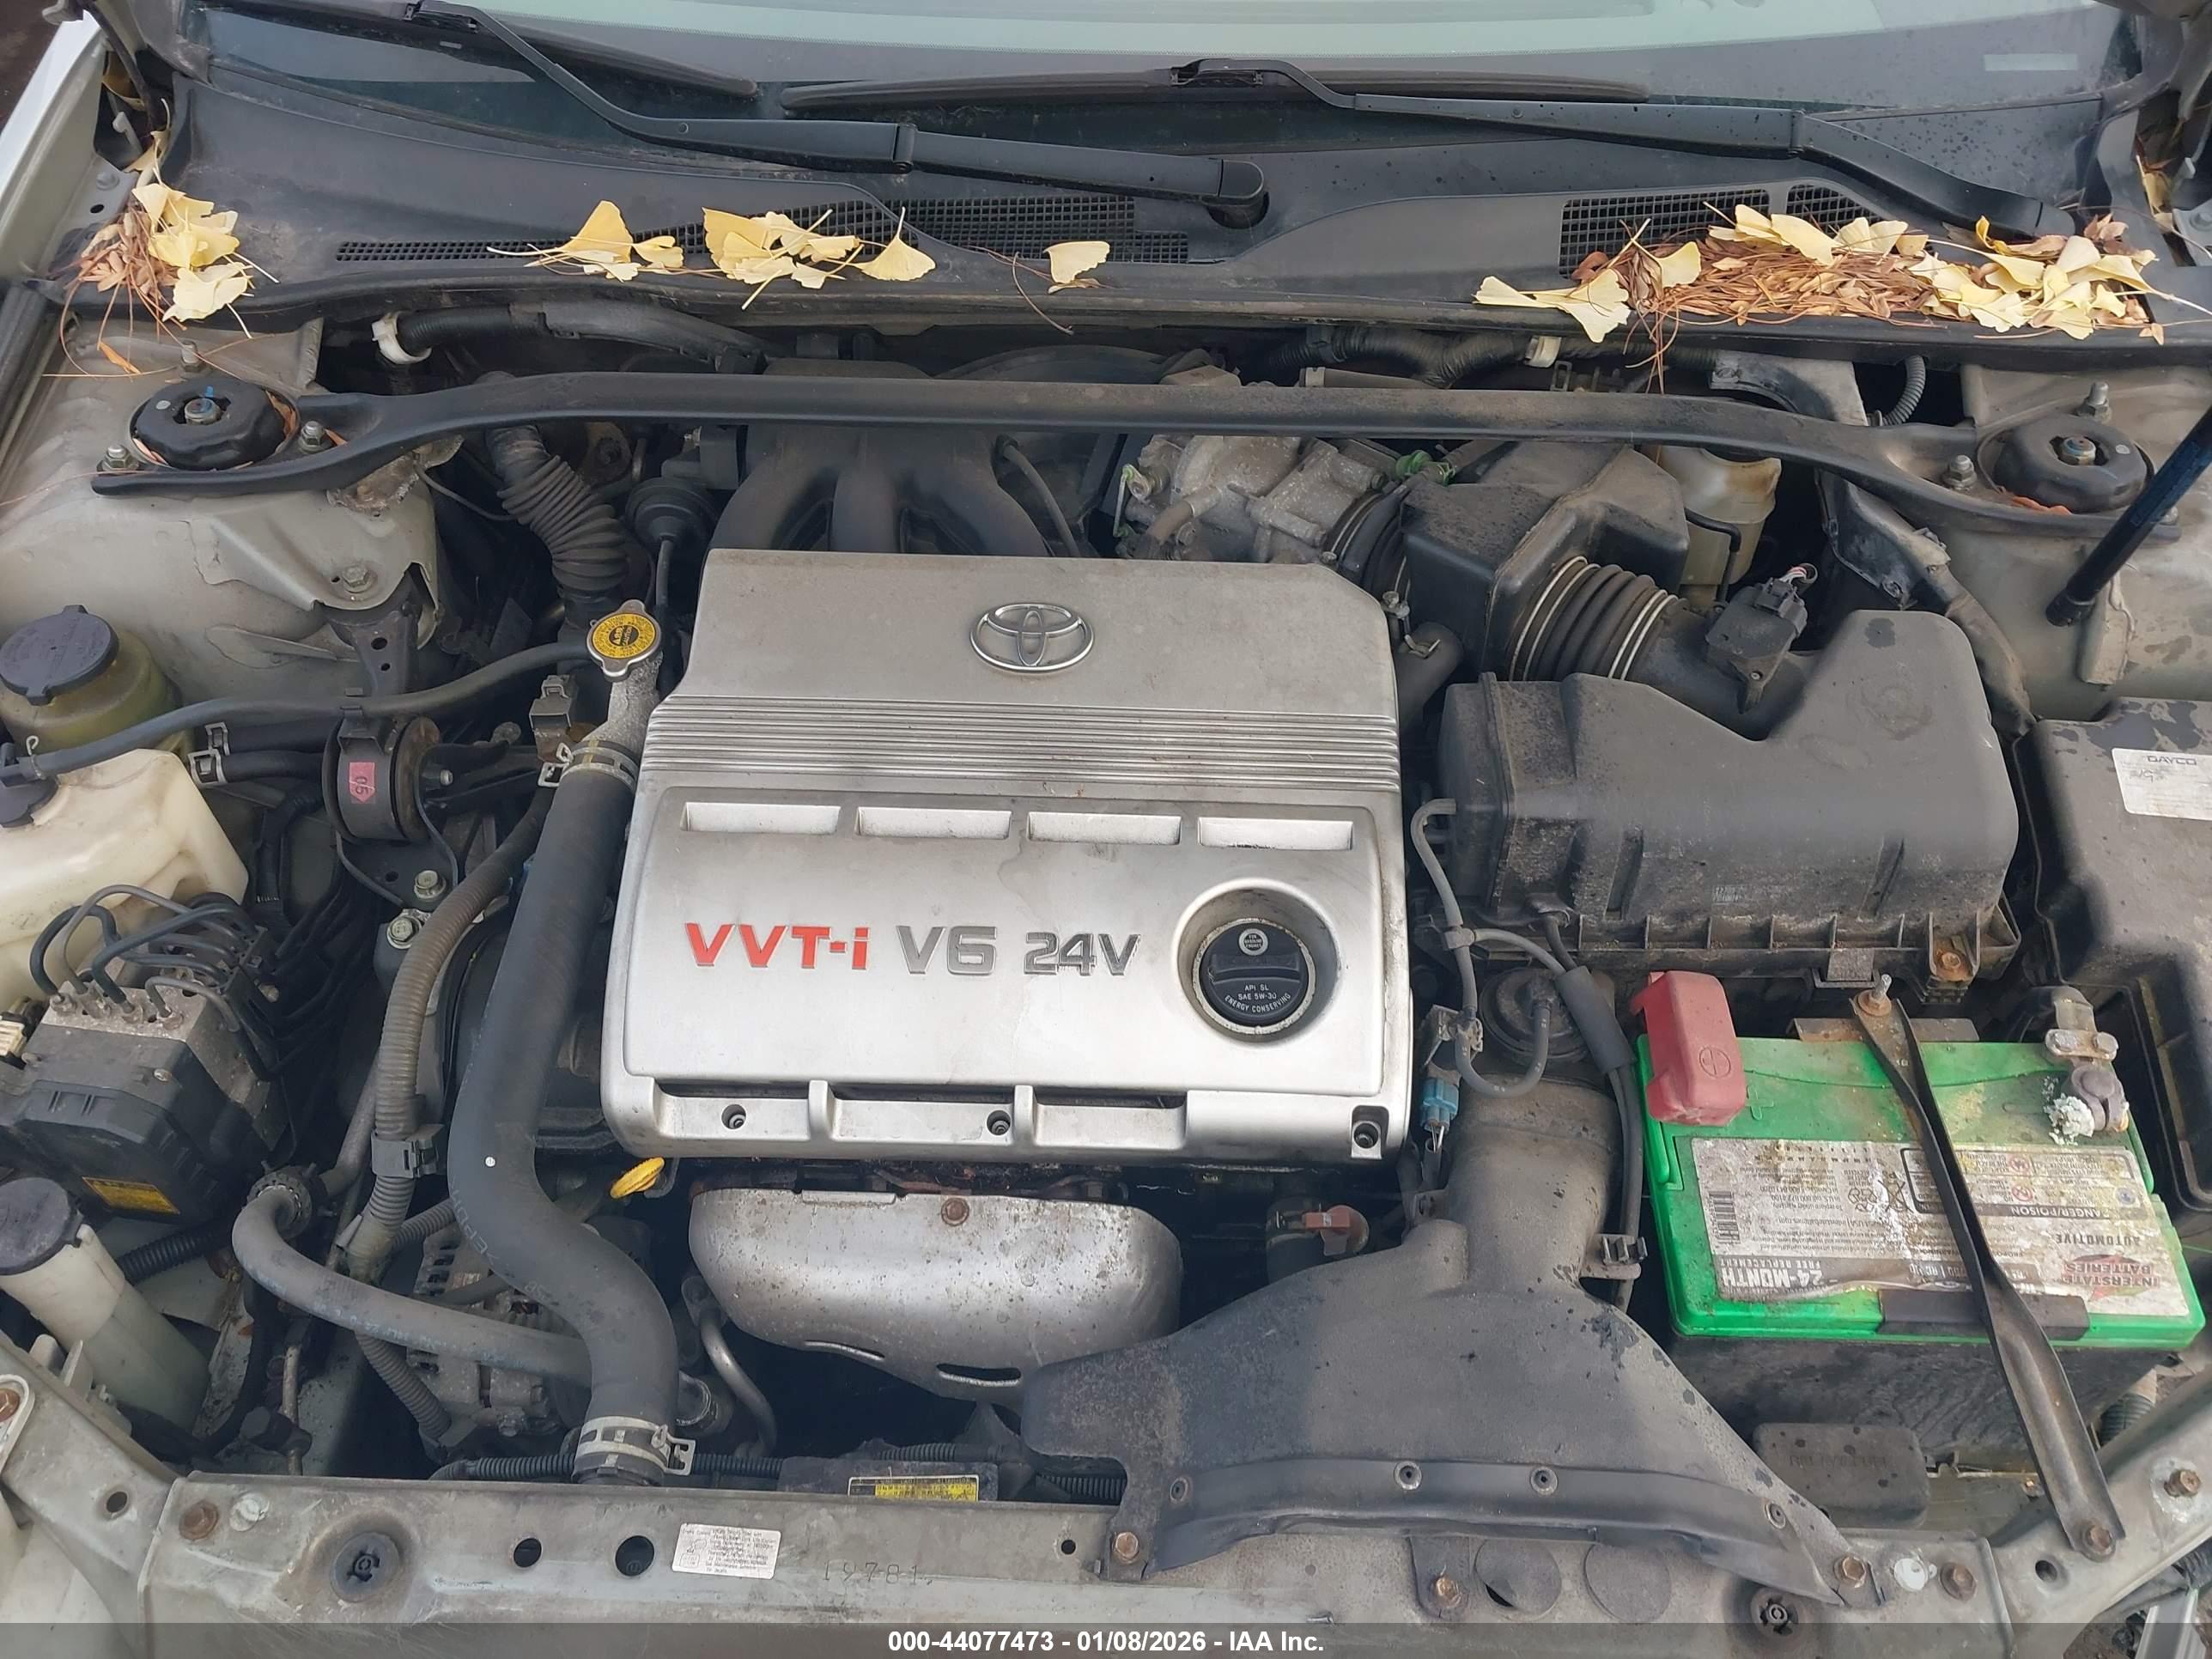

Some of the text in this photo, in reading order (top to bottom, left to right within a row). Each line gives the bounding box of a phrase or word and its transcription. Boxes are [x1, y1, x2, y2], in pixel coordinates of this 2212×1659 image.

[2147, 756, 2197, 765] DAYCO
[685, 923, 1141, 977] VVT-i V6 24V
[1224, 993, 1291, 1013] ENERGY CONSERVING
[2053, 1233, 2140, 1246] AUTOMOTIVE
[1719, 1258, 1821, 1269] FREE REPLACEMENT
[2065, 1263, 2152, 1275] BATTERIES
[1721, 1267, 1823, 1288] 24-MONTH
[2062, 1274, 2159, 1287] INTERSTATE
